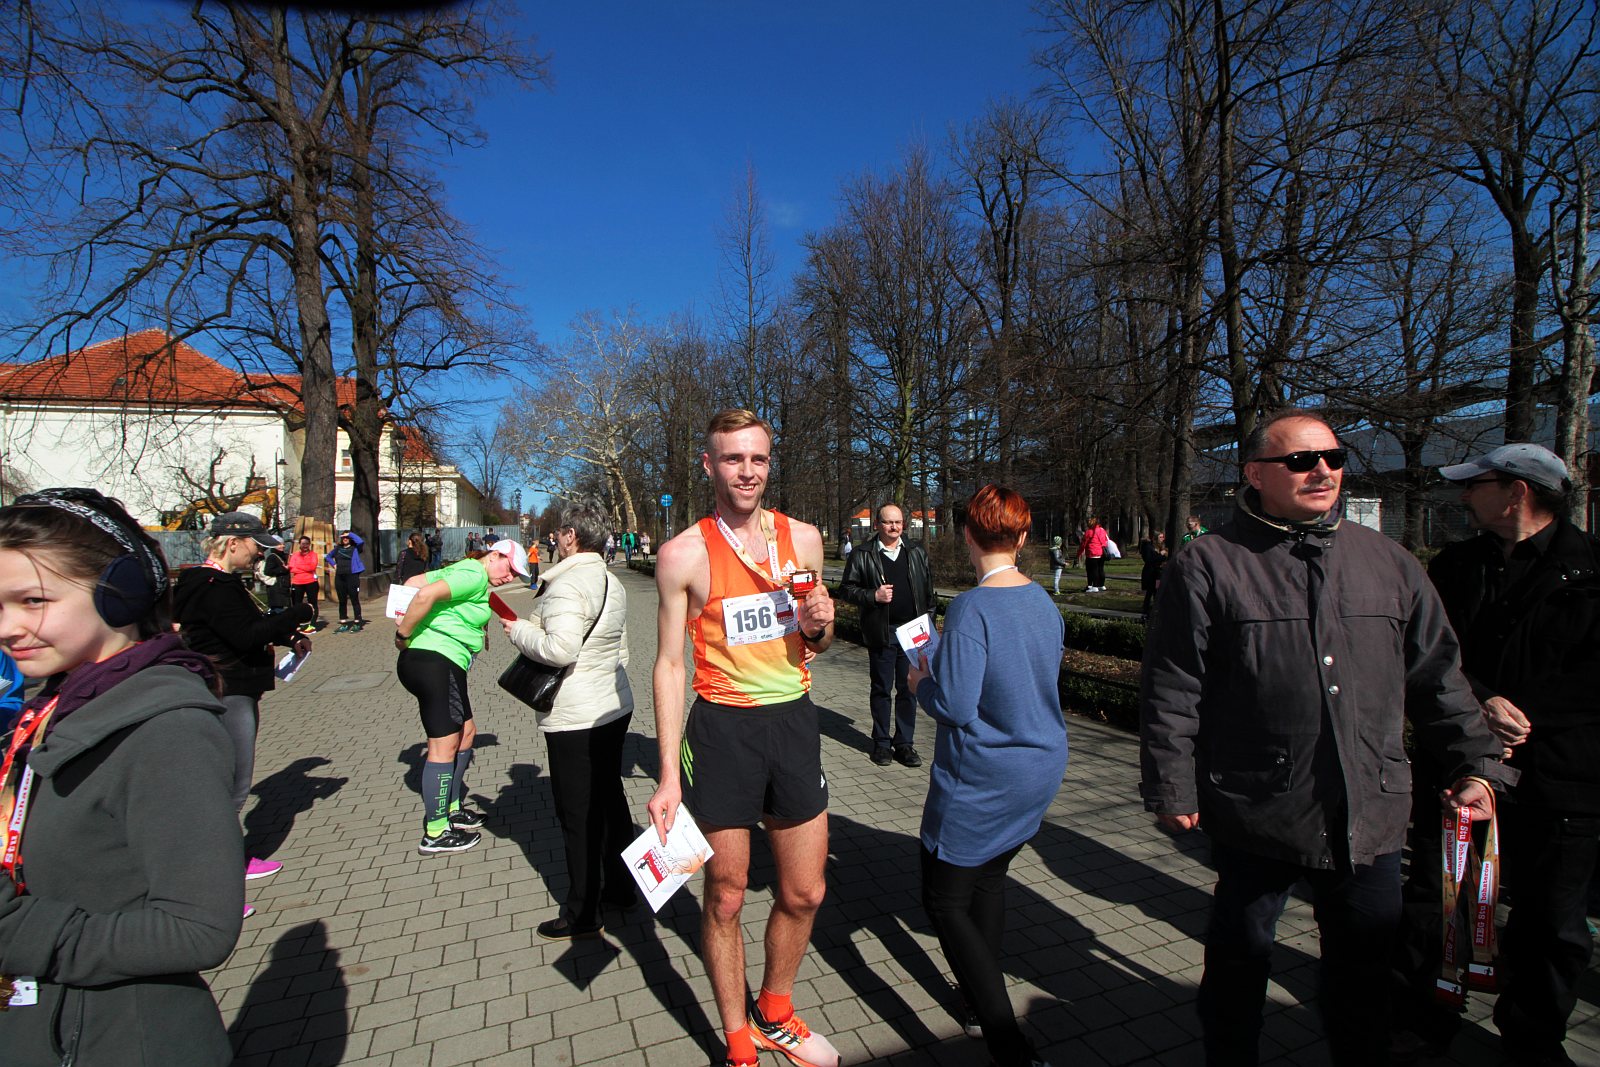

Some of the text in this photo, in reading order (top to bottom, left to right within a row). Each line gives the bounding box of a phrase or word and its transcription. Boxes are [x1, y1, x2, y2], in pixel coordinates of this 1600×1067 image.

[733, 606, 772, 633] 156
[4, 835, 18, 864] Stu
[1476, 922, 1485, 945] BIEG
